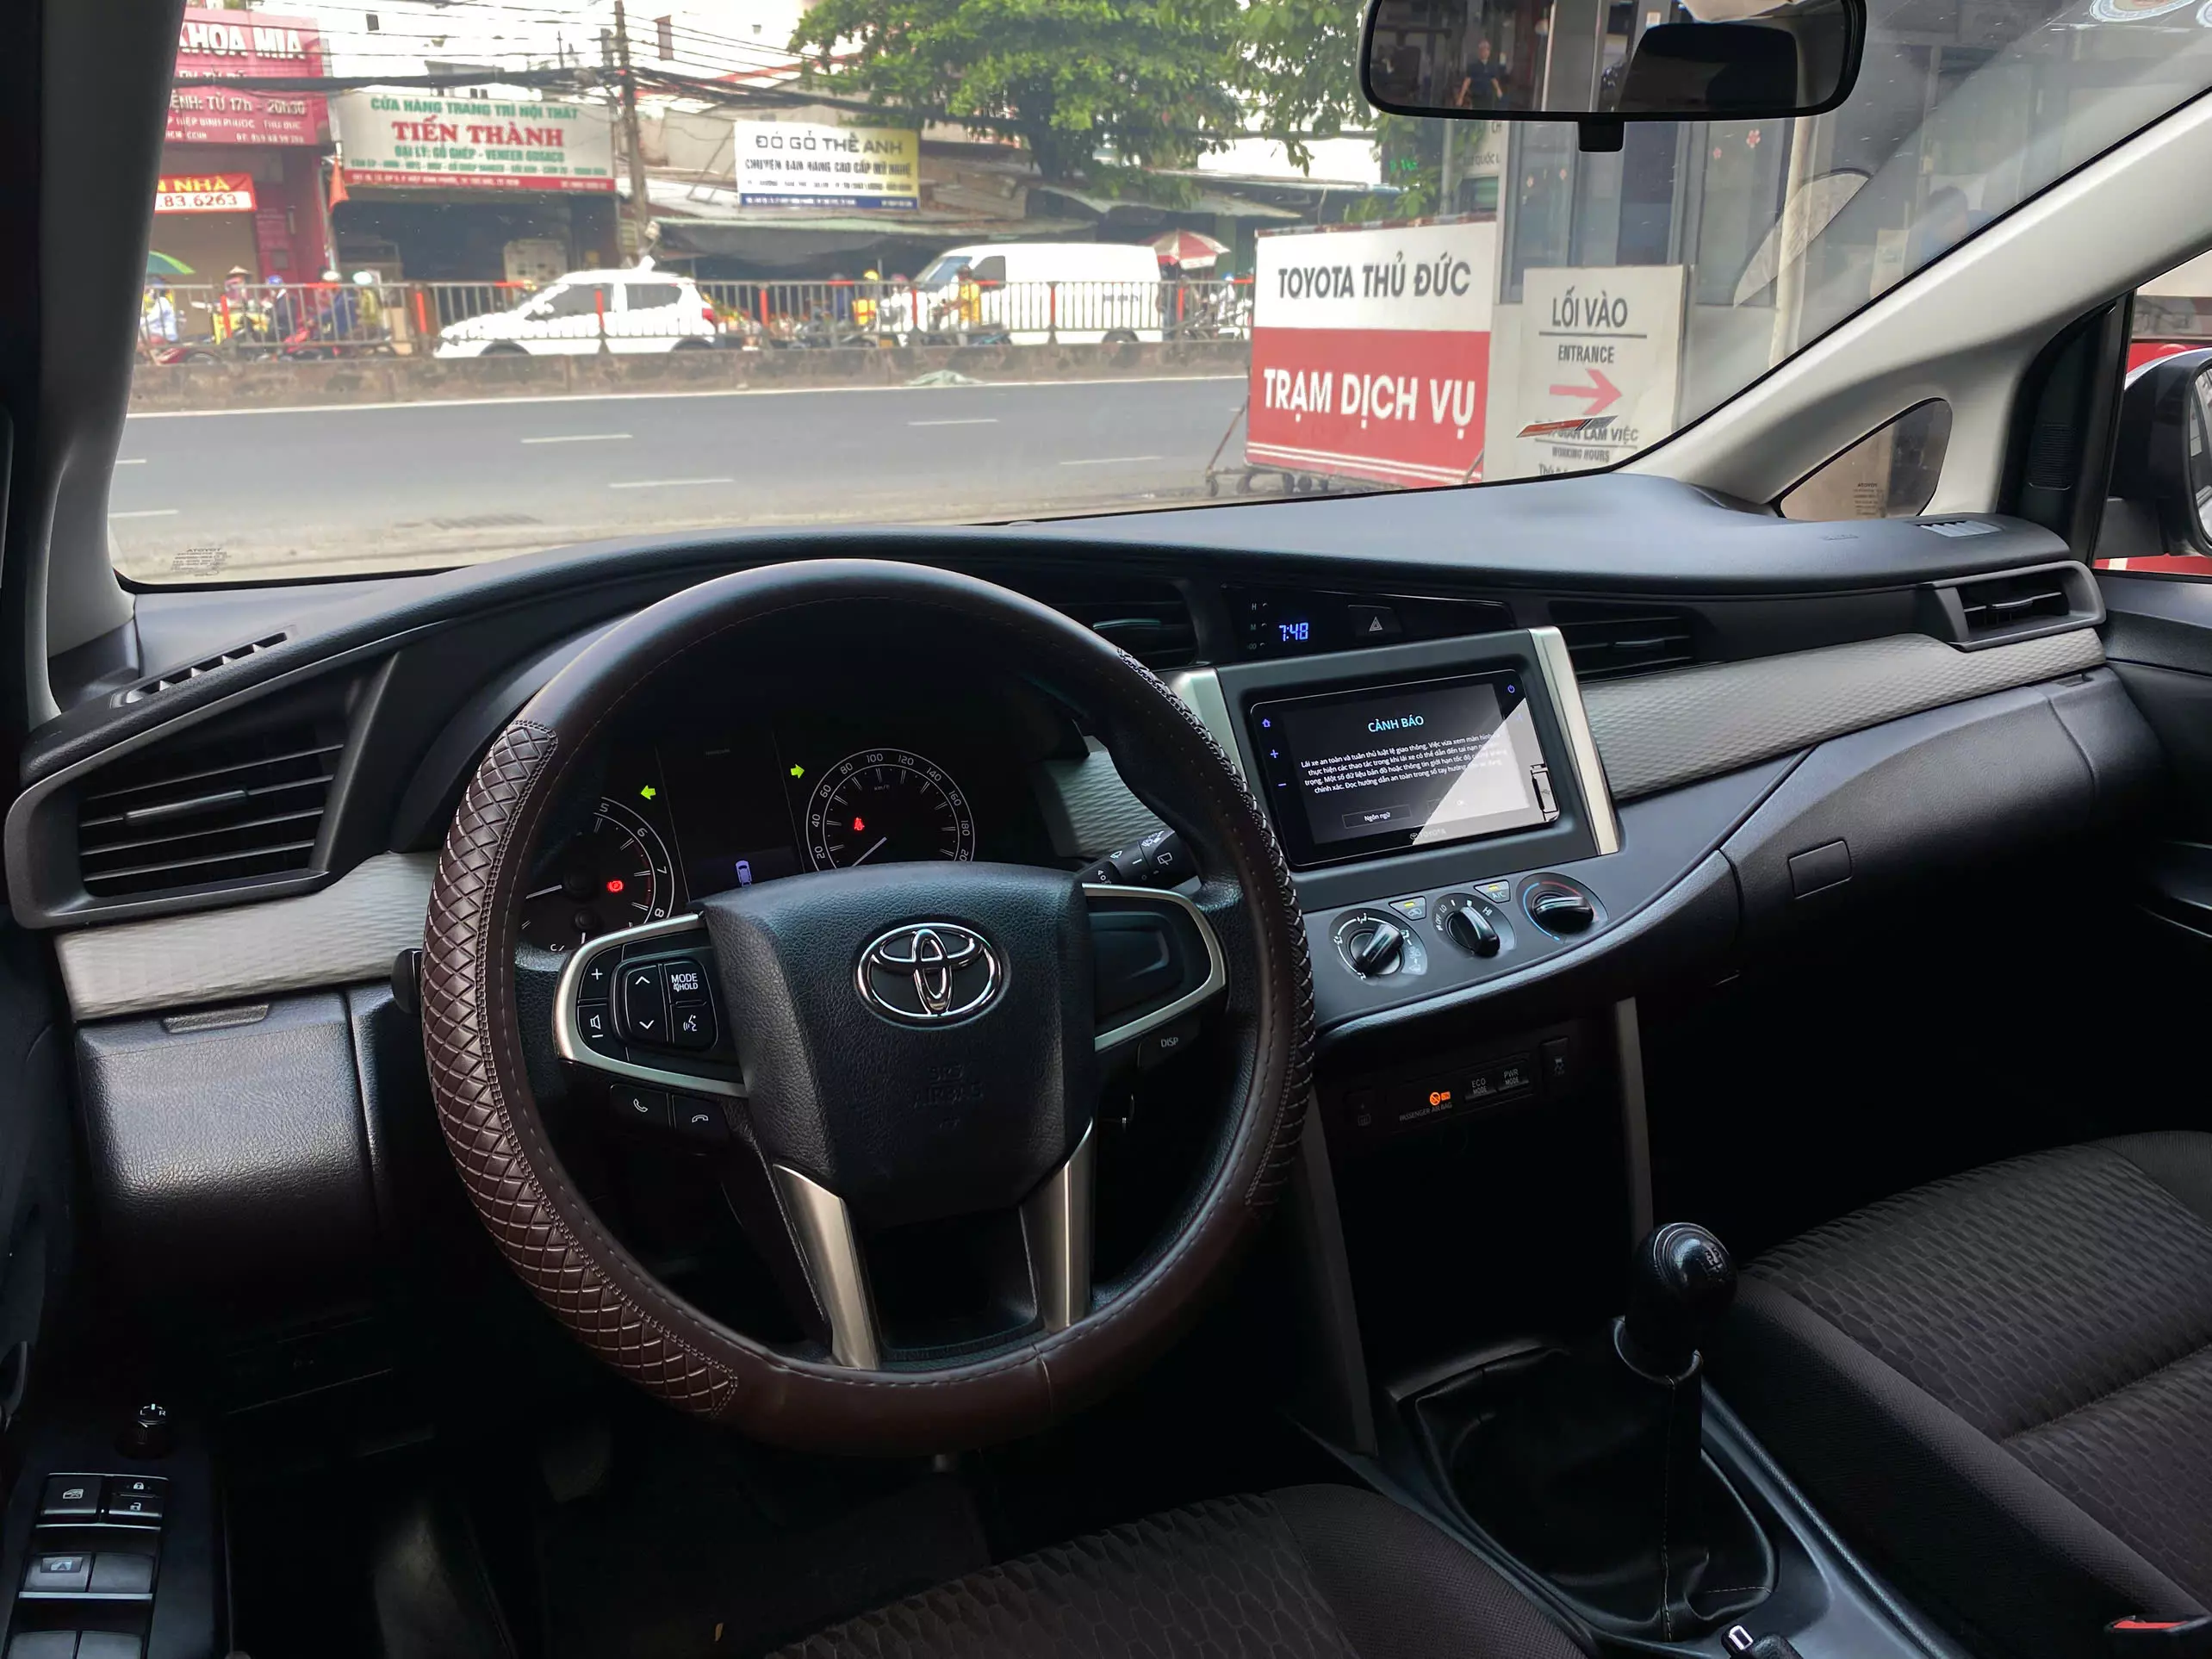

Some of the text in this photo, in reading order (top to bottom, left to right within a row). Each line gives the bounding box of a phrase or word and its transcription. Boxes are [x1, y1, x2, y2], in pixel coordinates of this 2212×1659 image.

[252, 27, 305, 59] MIA
[391, 115, 565, 147] TIẾN THÀNH
[863, 140, 903, 155] ANH
[1278, 251, 1471, 299] TOYOTA THỦ ĐỨC
[1551, 286, 1628, 328] LỐI VÀO
[1557, 344, 1615, 364] ENTRANCE
[1264, 368, 1476, 439] TRẠM DỊCH VỤ
[1611, 426, 1639, 444] VIỆC
[1583, 449, 1610, 463] HOURS
[1279, 622, 1309, 642] 7:48
[1368, 715, 1424, 732] CẢNH BÁO
[866, 752, 884, 764] 100
[898, 754, 915, 766] 120
[839, 762, 854, 775] 80
[926, 767, 942, 782] 140
[819, 783, 832, 798] 60
[948, 790, 962, 807] 160
[600, 802, 610, 813] 5
[811, 813, 821, 828] 40
[960, 819, 970, 836] 180
[637, 827, 648, 838] 6
[814, 845, 825, 860] 20
[656, 865, 668, 874] 7
[654, 907, 665, 918] 8
[1482, 906, 1493, 916] HI
[672, 973, 698, 984] MODE
[1160, 1036, 1179, 1048] DISP
[1503, 1069, 1519, 1078] PWR
[1471, 1078, 1486, 1088] ECO
